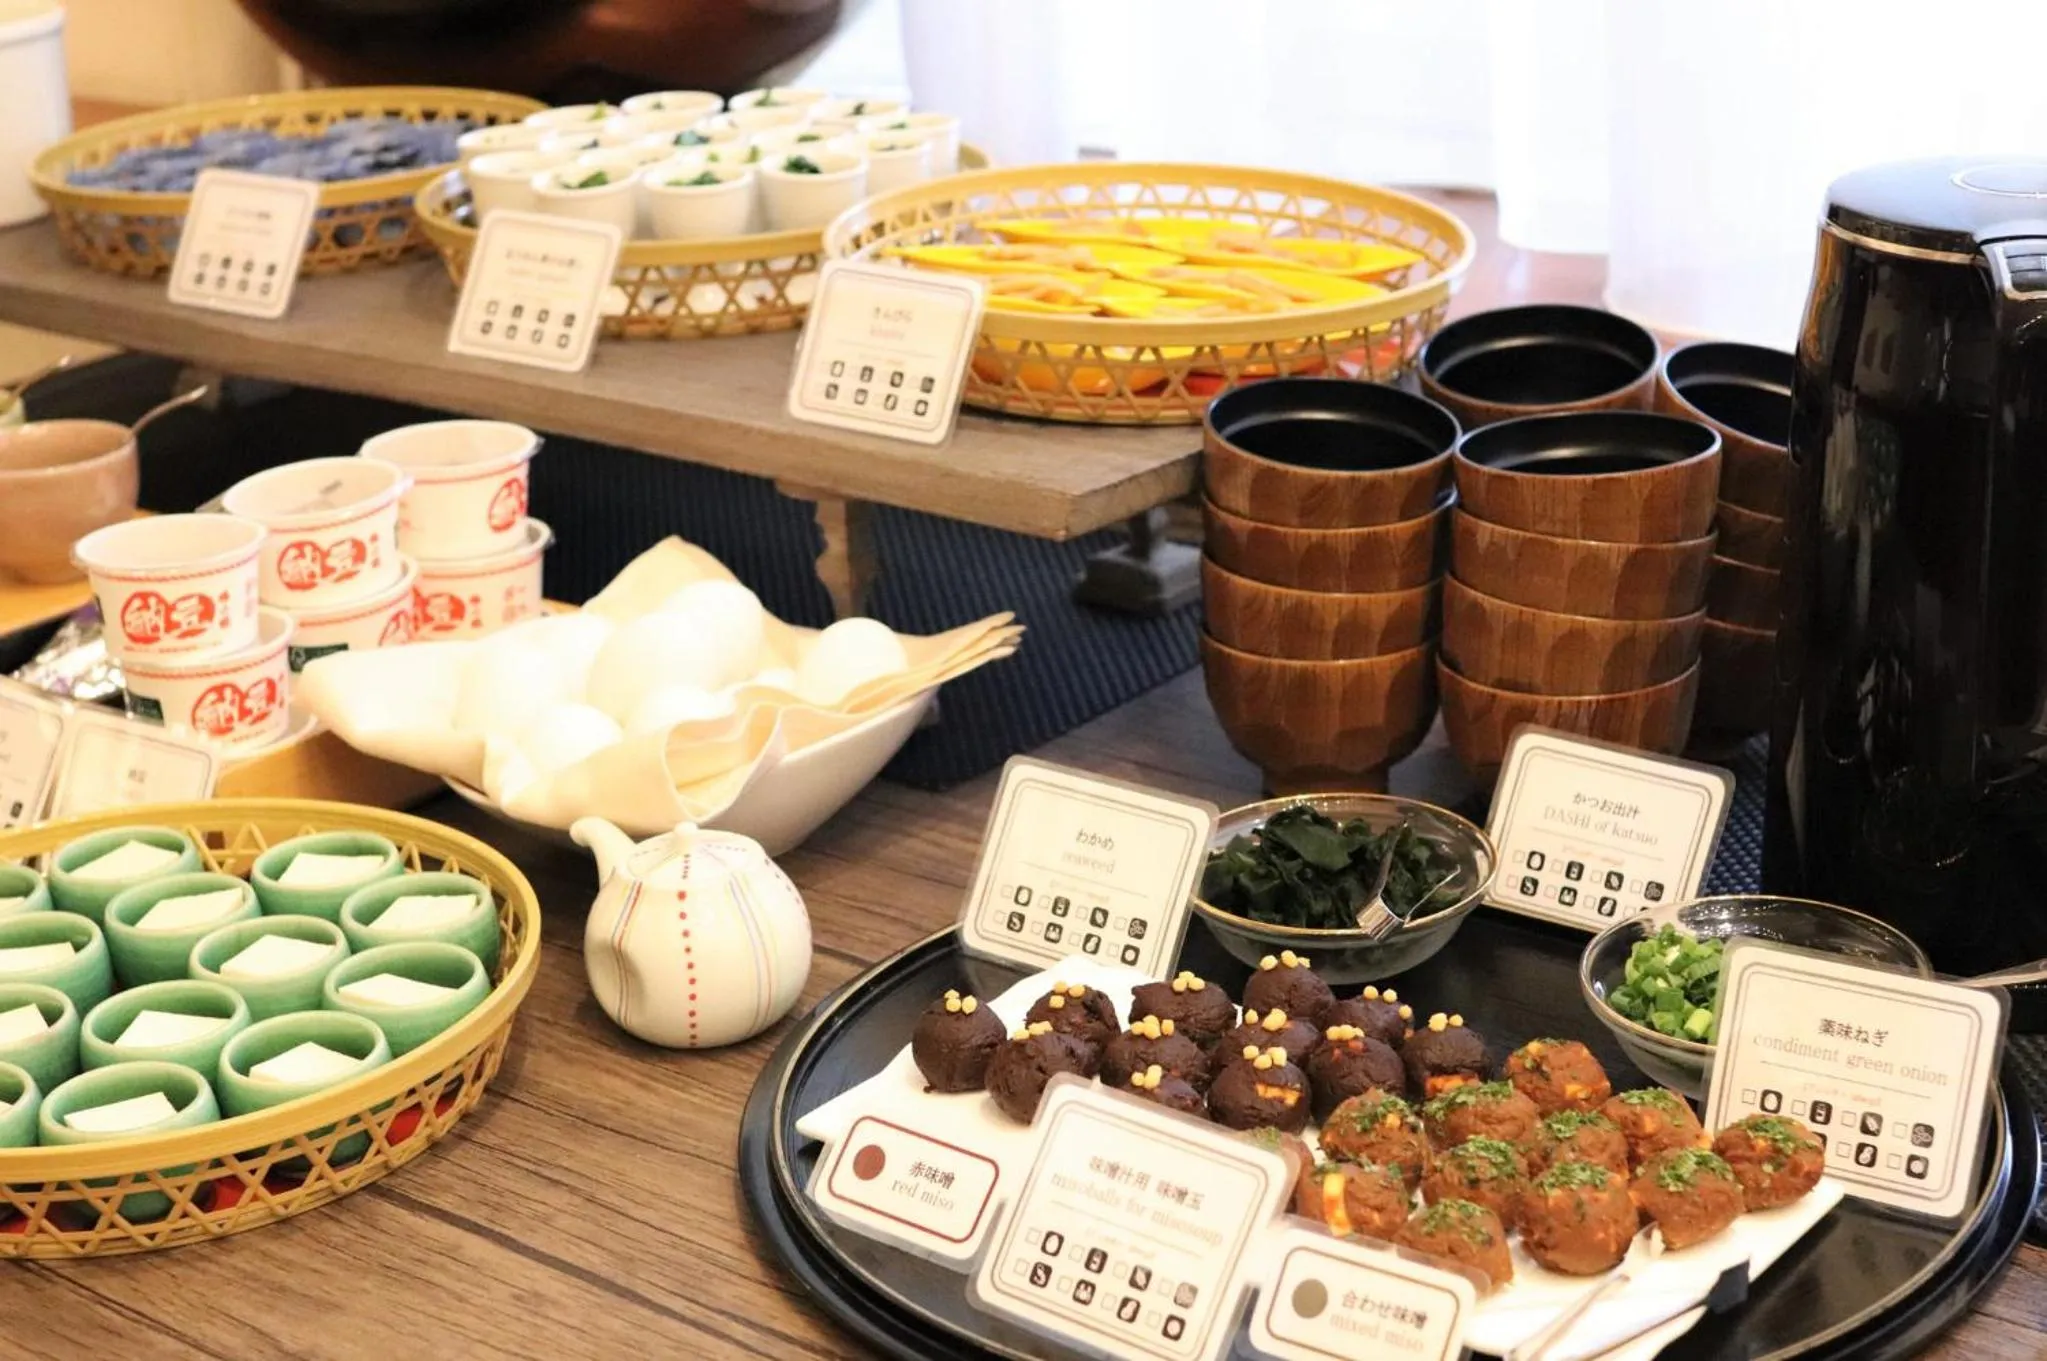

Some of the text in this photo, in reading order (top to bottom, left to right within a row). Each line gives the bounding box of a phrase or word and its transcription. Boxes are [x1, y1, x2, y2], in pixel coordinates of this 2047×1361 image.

[1543, 804, 1591, 830] DASHI
[1594, 819, 1610, 836] of
[1572, 792, 1641, 820] かつお出汁
[1076, 828, 1115, 850] わかめ
[1818, 1017, 1889, 1047] 薬味ねぎ
[1753, 1032, 1949, 1086] condiment green onion
[909, 1161, 956, 1190] 赤味噌
[1089, 1154, 1206, 1211] 味噌汁用 味噌玉
[891, 1179, 955, 1211] red miso
[1342, 1290, 1429, 1330] 合わせ味噌
[1329, 1312, 1425, 1352] mixed miso
